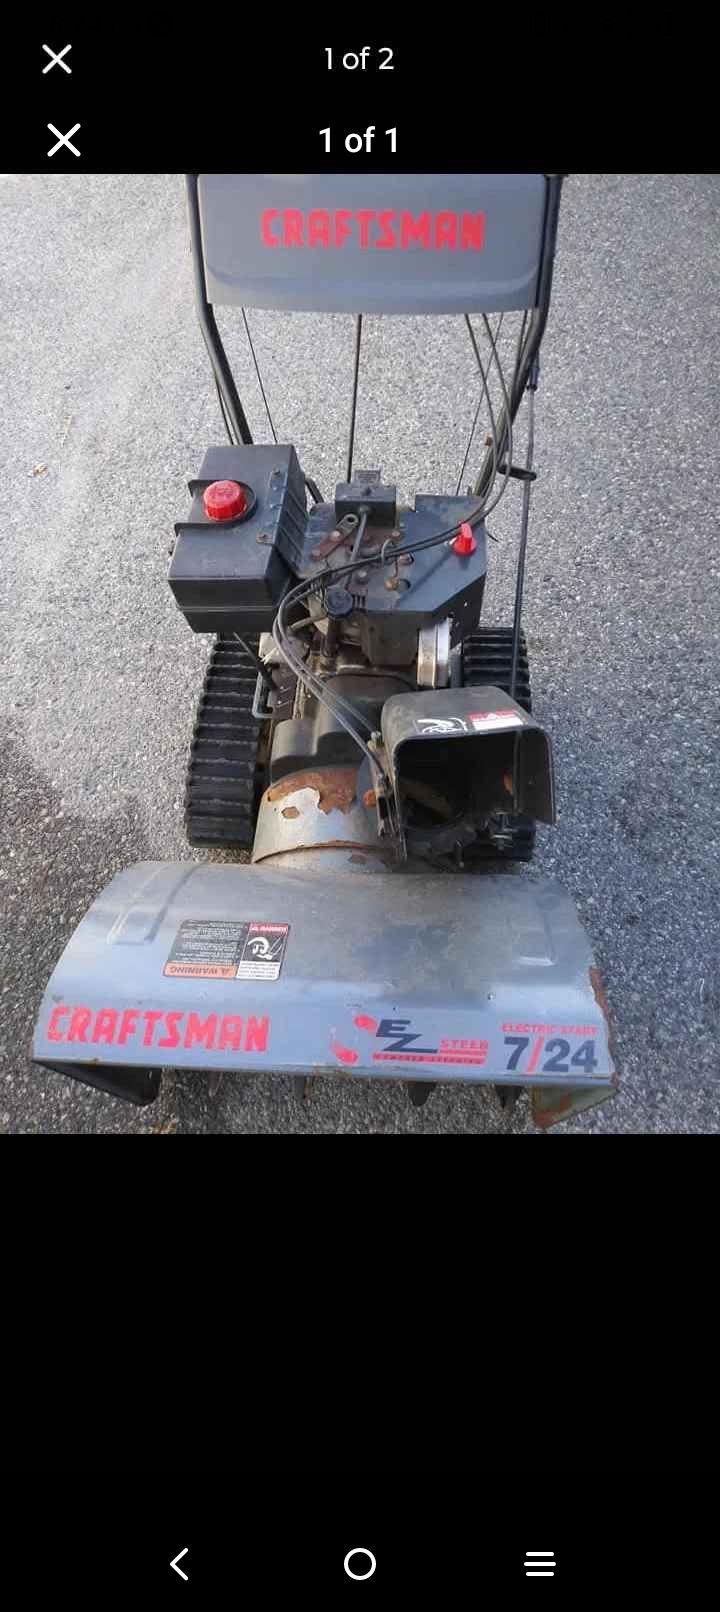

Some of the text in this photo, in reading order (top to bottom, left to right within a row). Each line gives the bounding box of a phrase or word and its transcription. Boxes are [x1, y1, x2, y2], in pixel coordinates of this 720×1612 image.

[260, 208, 486, 252] CRAFTSMAN
[169, 966, 218, 976] WARNING
[48, 1005, 271, 1053] CRAFTSMAN
[376, 1019, 438, 1054] EZ
[504, 1036, 598, 1075] 7/24
